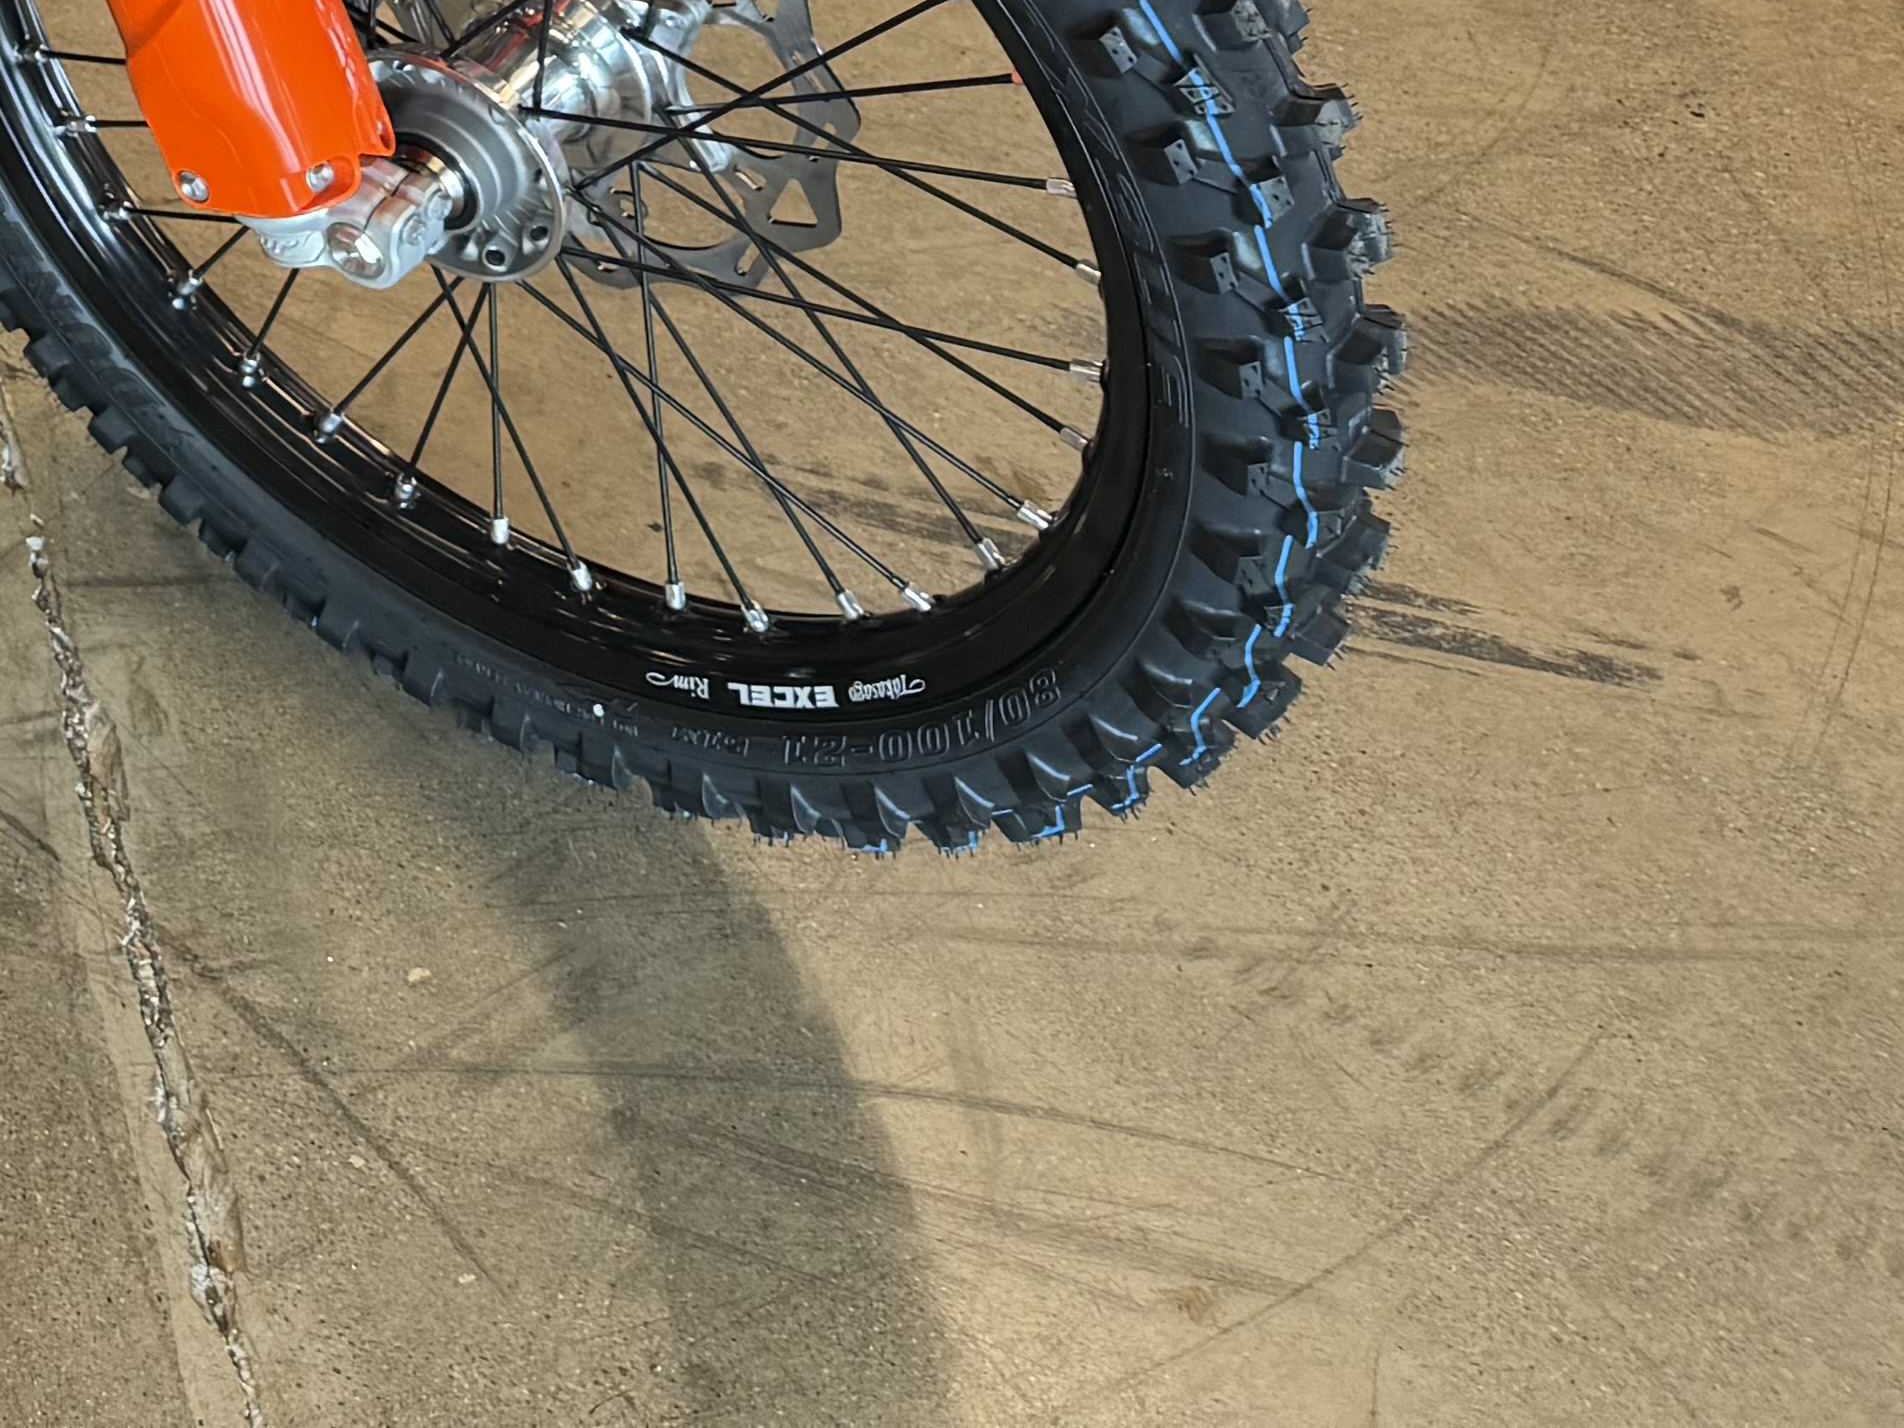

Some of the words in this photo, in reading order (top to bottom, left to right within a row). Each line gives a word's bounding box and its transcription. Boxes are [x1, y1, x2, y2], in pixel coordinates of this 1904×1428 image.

[645, 670, 711, 700] Rim
[727, 682, 841, 710] EXCEL
[848, 673, 927, 703] Takasago
[781, 667, 1062, 768] 80/100-21
